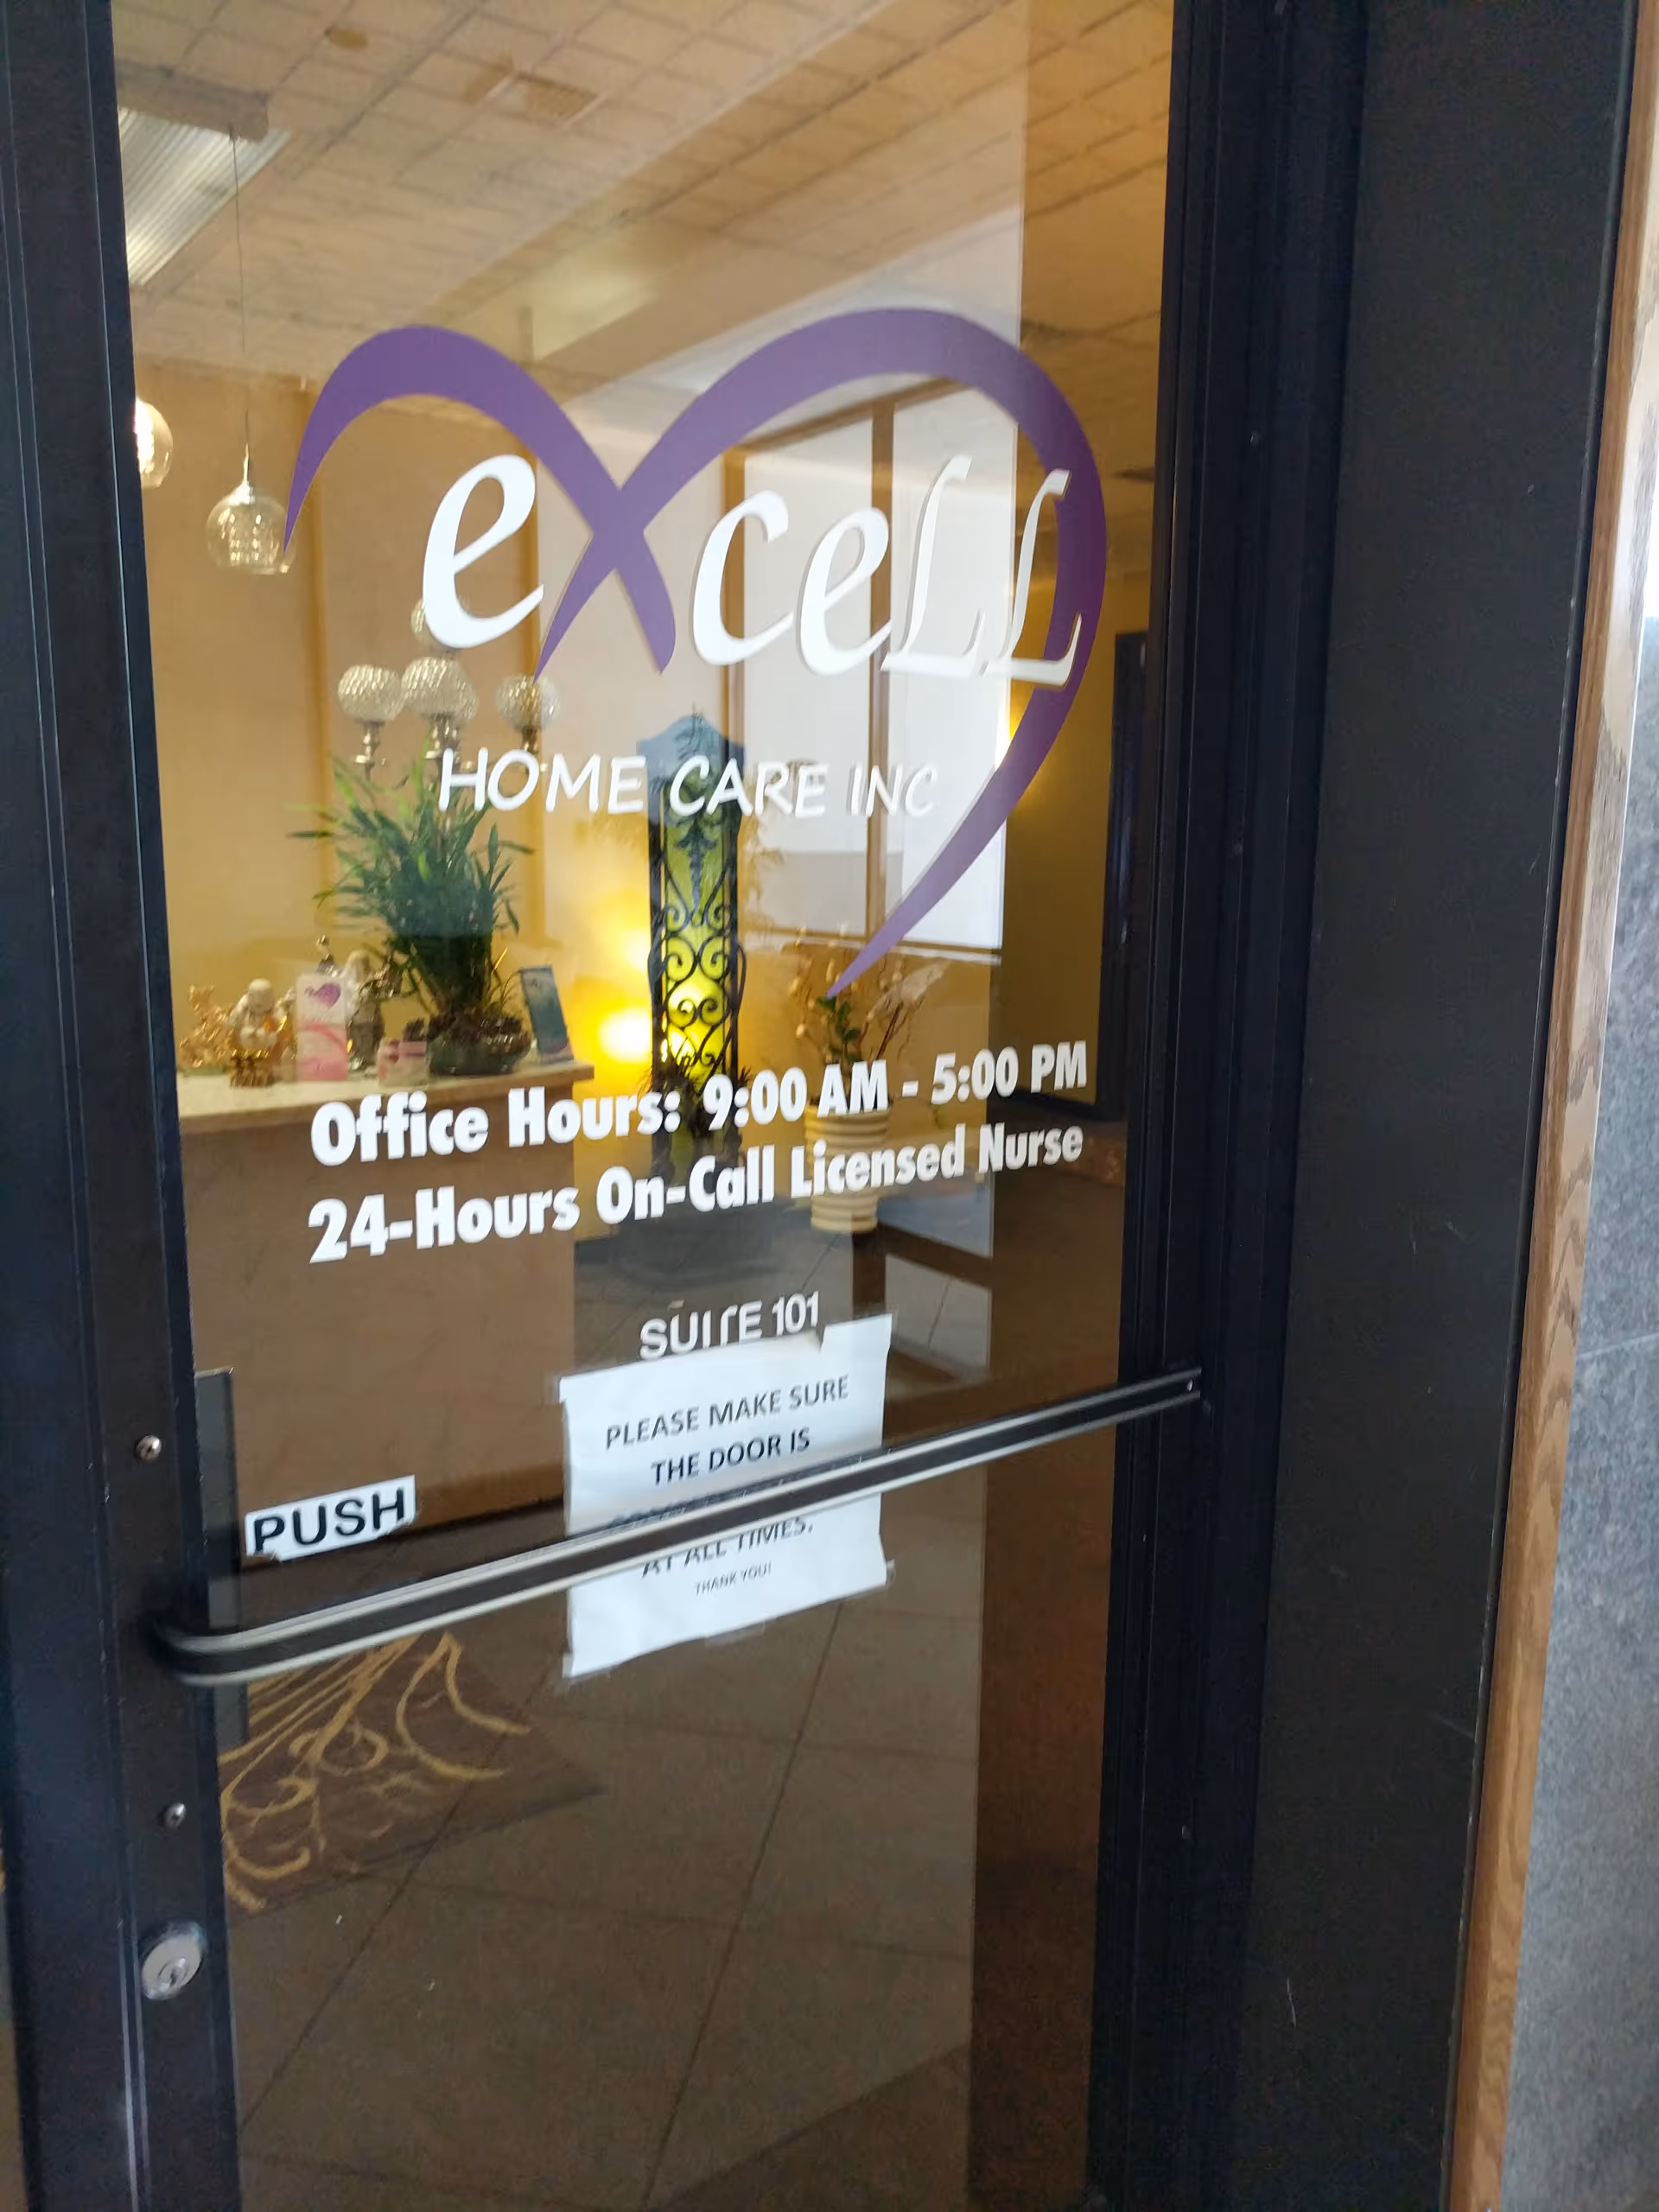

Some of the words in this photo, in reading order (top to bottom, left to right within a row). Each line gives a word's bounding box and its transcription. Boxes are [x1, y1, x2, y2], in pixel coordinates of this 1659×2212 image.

[437, 747, 648, 815] HOME
[668, 754, 830, 817] CARE
[849, 760, 938, 818] INC
[310, 1090, 490, 1166] Office
[508, 1085, 682, 1148] Hours:
[702, 1066, 808, 1131] 9:00
[817, 1058, 888, 1118] AM
[901, 1079, 919, 1098] -
[931, 1046, 1019, 1105] 5:00
[1030, 1039, 1087, 1093] PM
[308, 1185, 581, 1264] 24-Hours
[595, 1144, 775, 1224] On-Call
[791, 1123, 966, 1199] Licensed
[978, 1122, 1084, 1175] Nurse
[639, 1300, 763, 1361] SUITE
[771, 1289, 819, 1336] 101
[605, 1406, 700, 1451] PLEASE
[709, 1389, 782, 1429] MAKE
[788, 1374, 850, 1411] SURE
[650, 1451, 701, 1486] THE
[709, 1433, 782, 1473] DOOR
[789, 1427, 810, 1454] IS
[253, 1487, 404, 1552] PUSH
[695, 1570, 737, 1596] THANK
